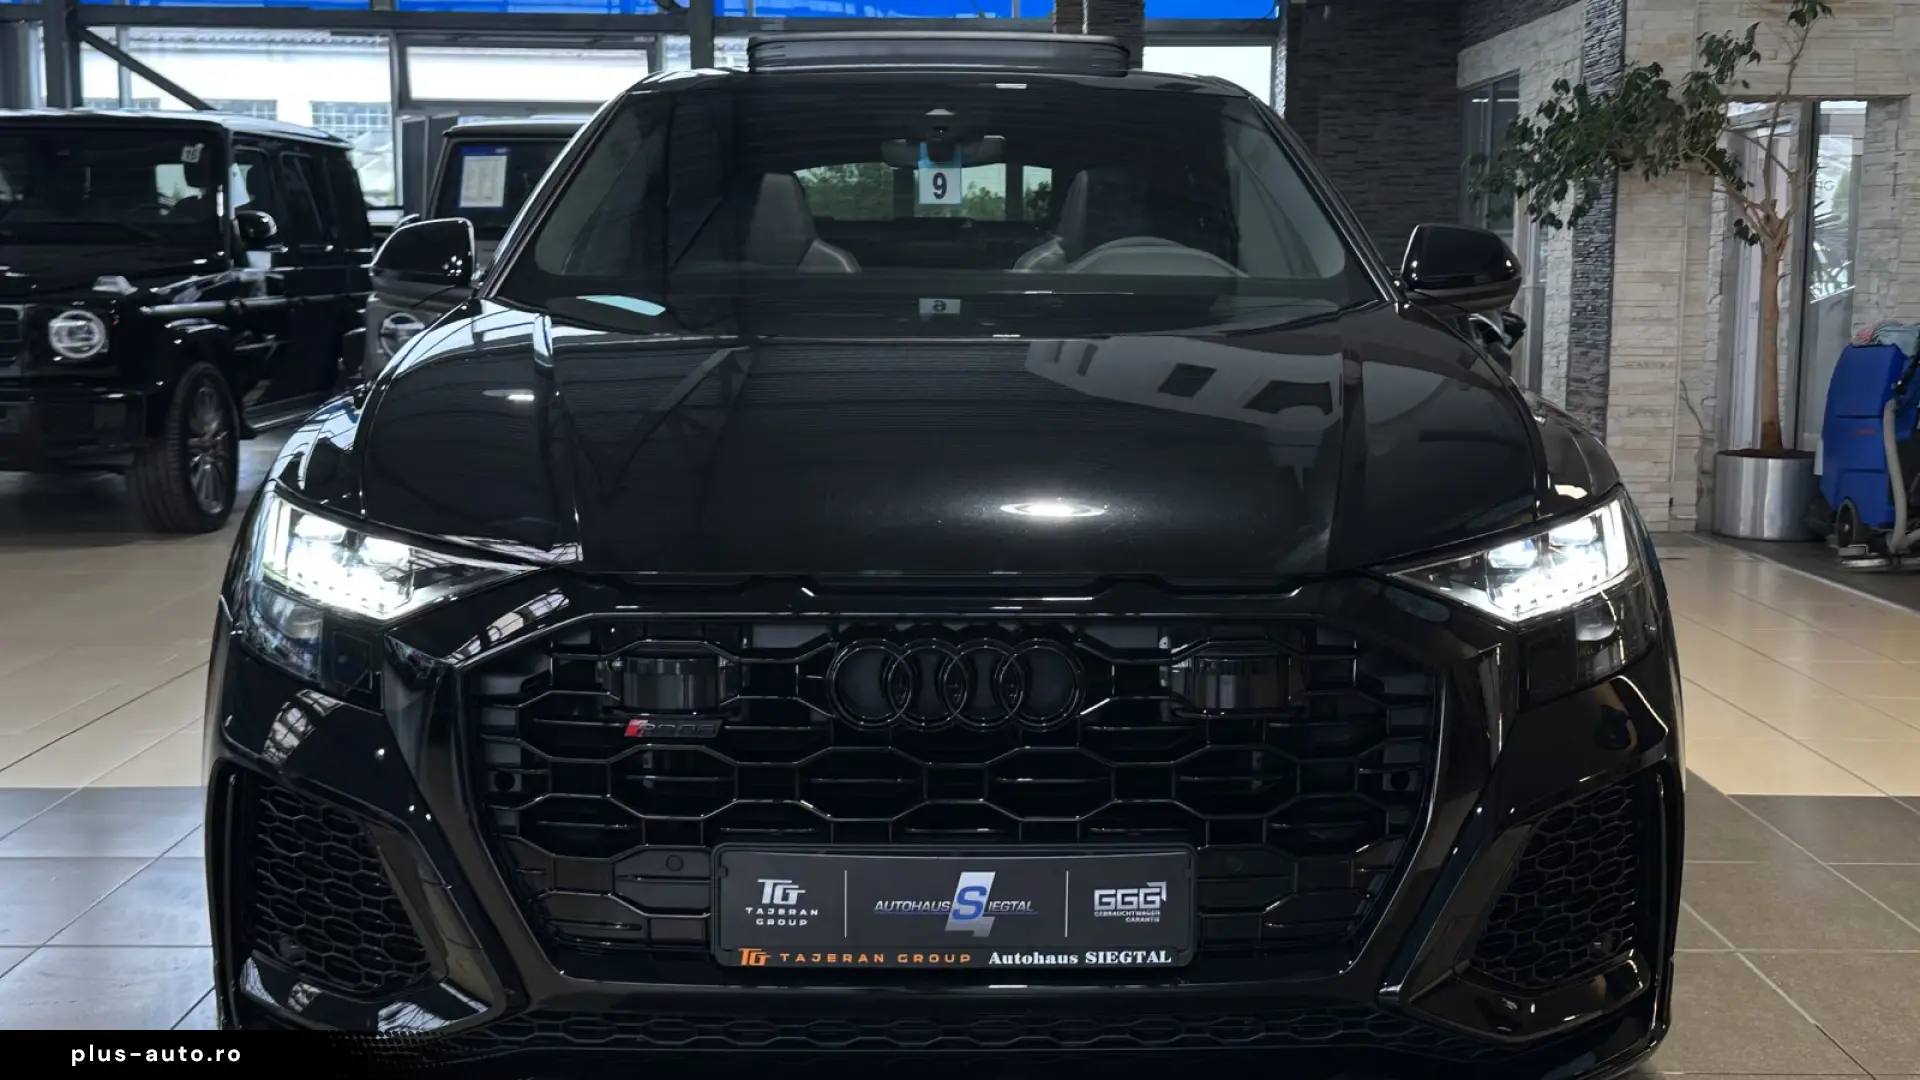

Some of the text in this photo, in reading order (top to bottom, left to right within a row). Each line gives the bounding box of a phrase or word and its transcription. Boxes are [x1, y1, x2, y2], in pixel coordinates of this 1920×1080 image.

[932, 172, 947, 199] 9
[757, 879, 806, 905] TG
[1094, 888, 1161, 910] GGG
[745, 907, 818, 916] TAJERAN
[873, 900, 951, 912] AUTOHAUS
[756, 918, 808, 926] GROUP
[780, 953, 885, 963] TAJERAN
[897, 953, 971, 963] GROUP
[988, 951, 1079, 965] Autohaus
[1085, 950, 1172, 964] SIEGTAL
